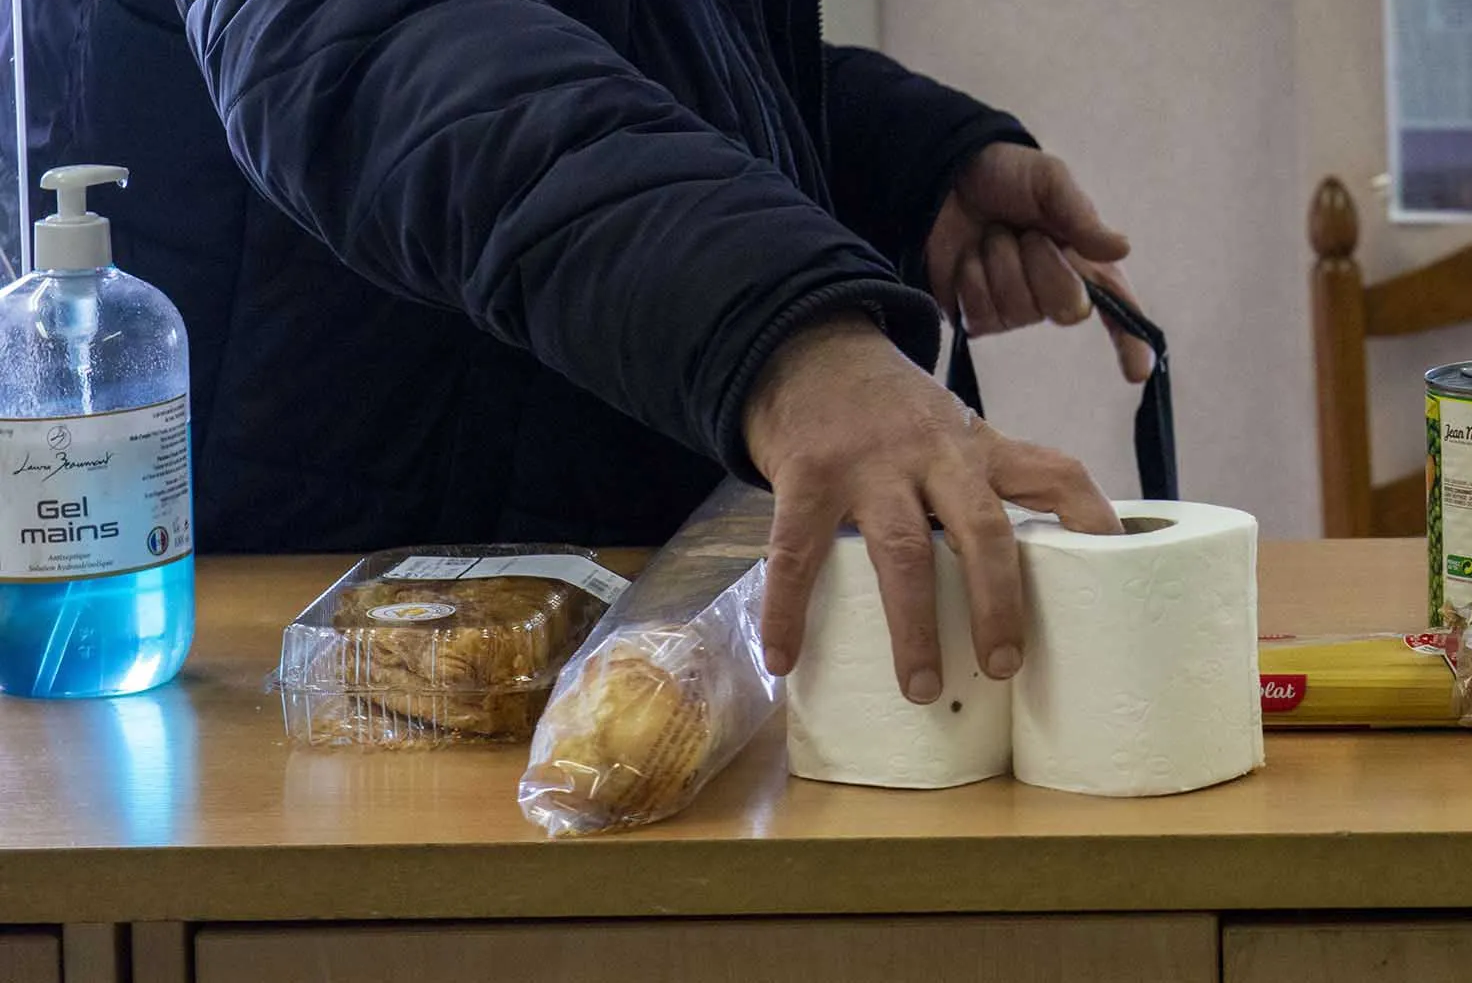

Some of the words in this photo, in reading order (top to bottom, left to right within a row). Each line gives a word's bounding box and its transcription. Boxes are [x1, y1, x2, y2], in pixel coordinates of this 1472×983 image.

[1444, 424, 1464, 441] Jean
[37, 496, 88, 519] Gel
[21, 521, 119, 544] mains
